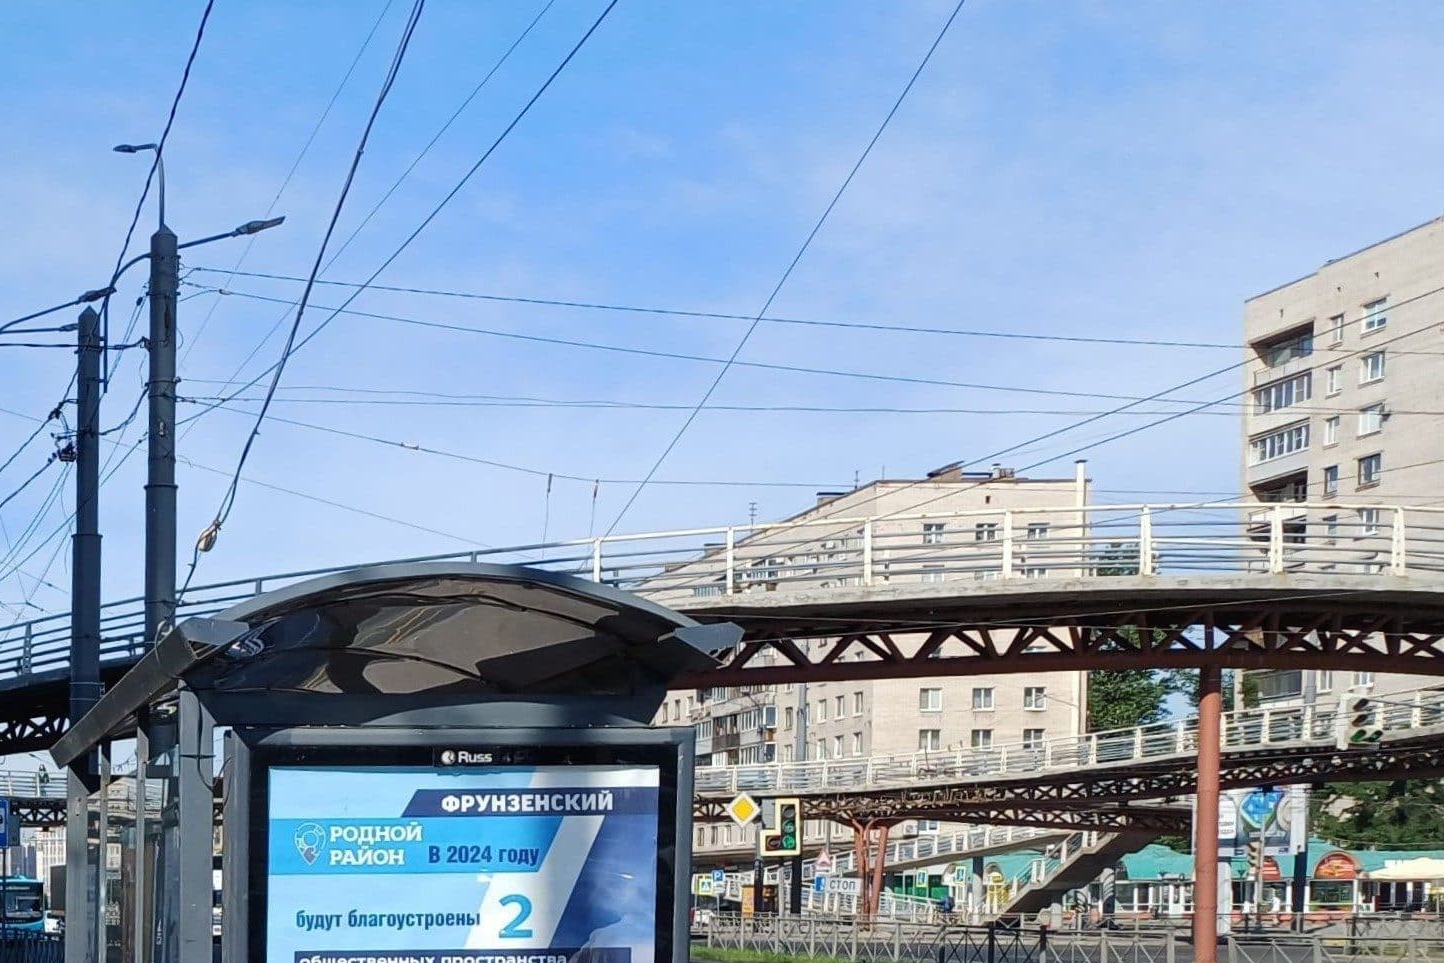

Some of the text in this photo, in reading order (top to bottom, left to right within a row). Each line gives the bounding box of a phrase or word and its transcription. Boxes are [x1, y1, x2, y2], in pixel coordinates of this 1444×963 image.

[458, 751, 493, 763] Russ
[441, 791, 613, 813] ФРУНЗЕНСКИЙ
[330, 822, 422, 844] РОДНОЙ
[329, 848, 405, 866] РАЙОН
[429, 846, 539, 866] В 2024 году
[829, 879, 856, 891] СТОП
[296, 910, 480, 931] будут благоустроены
[498, 894, 533, 938] 2
